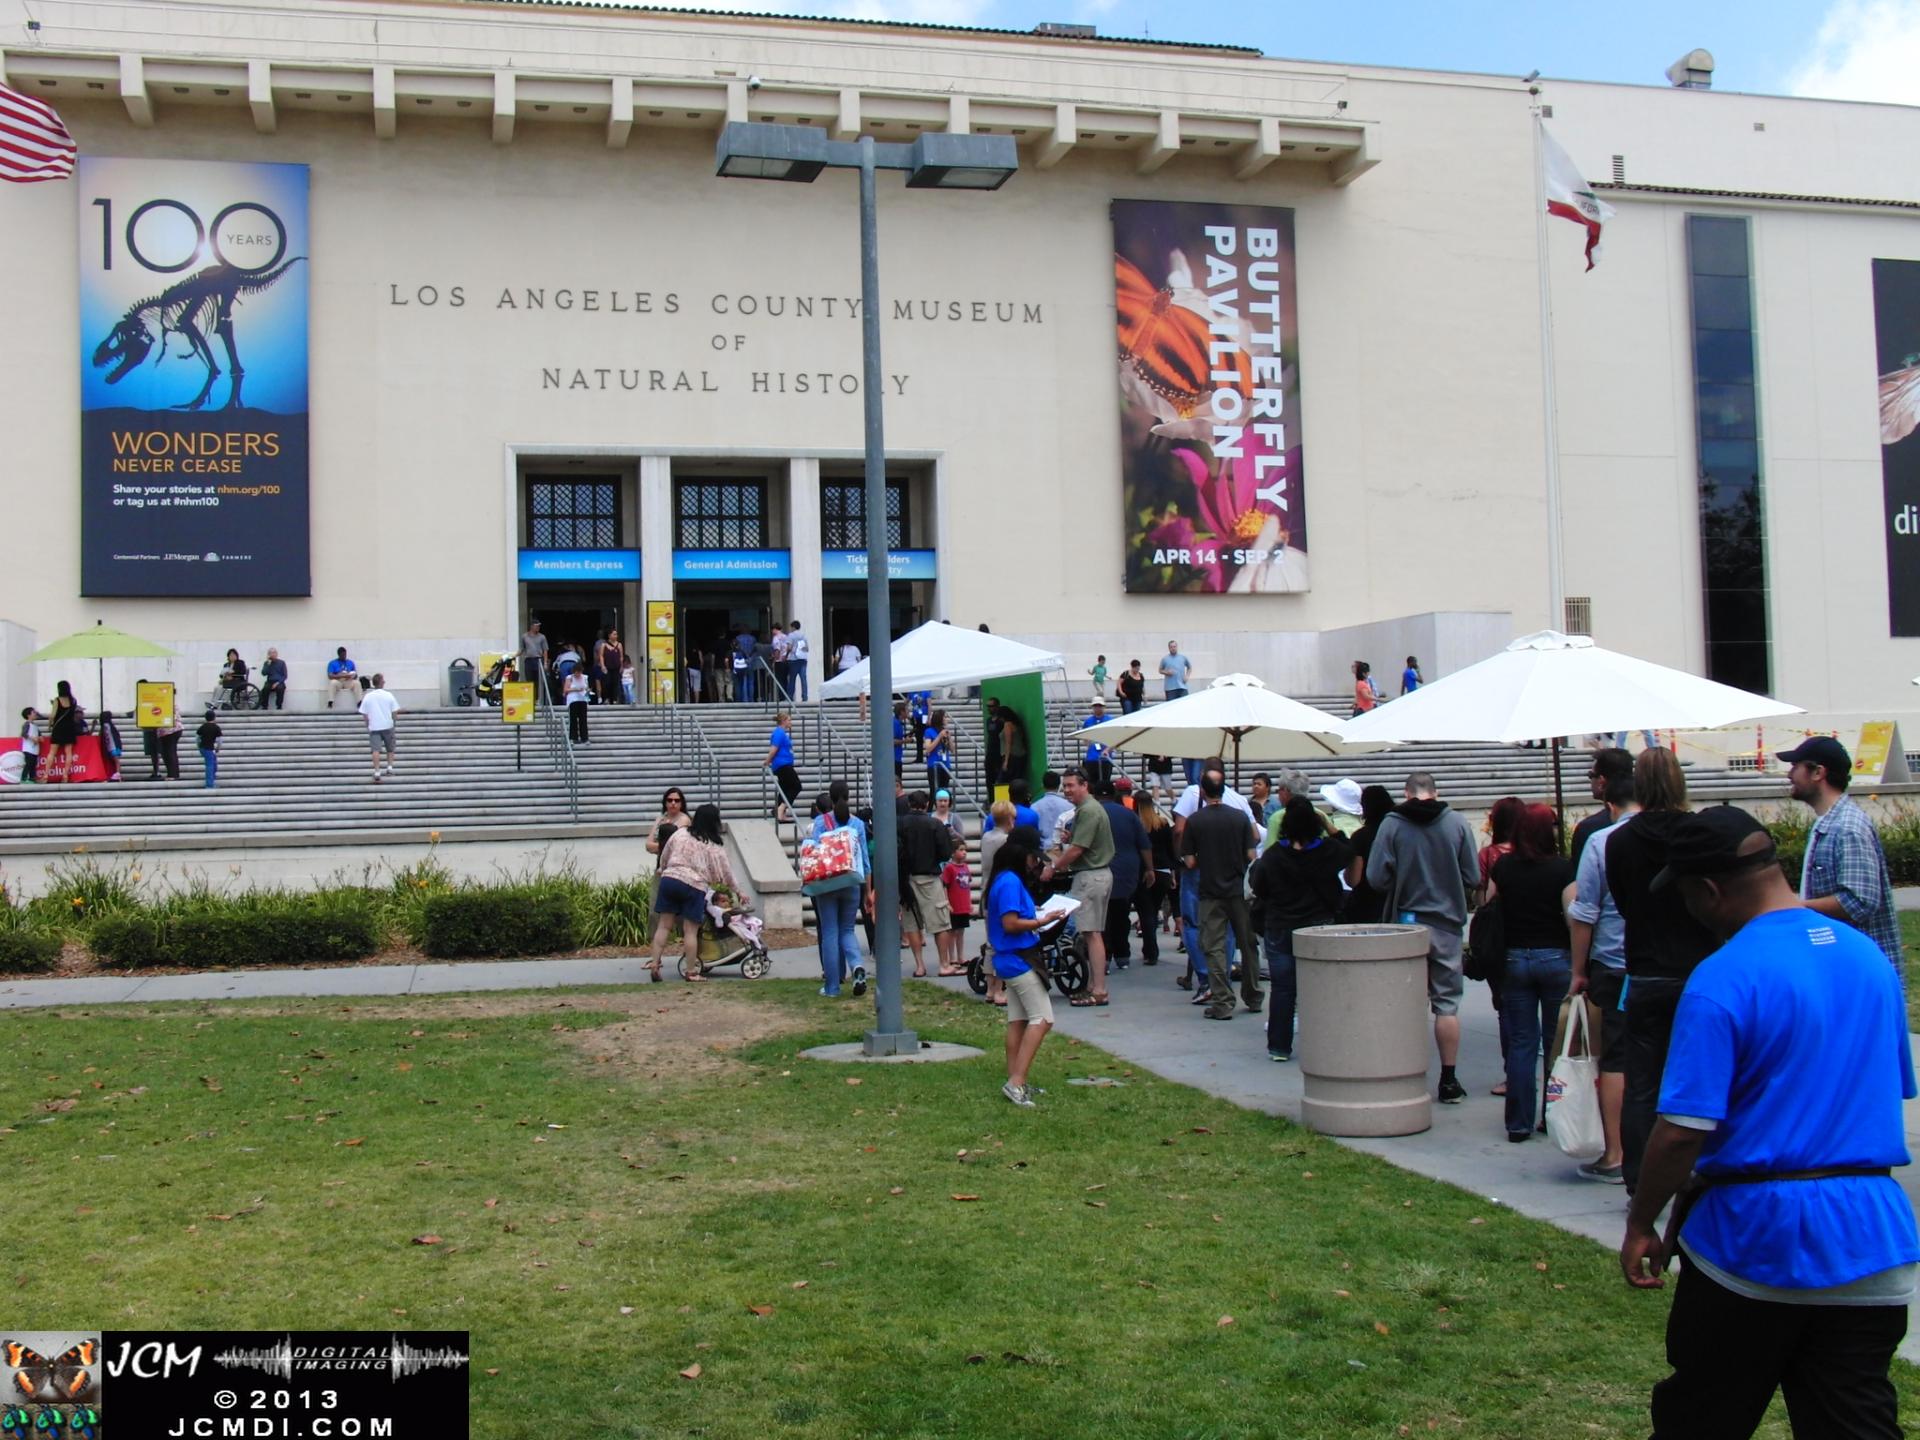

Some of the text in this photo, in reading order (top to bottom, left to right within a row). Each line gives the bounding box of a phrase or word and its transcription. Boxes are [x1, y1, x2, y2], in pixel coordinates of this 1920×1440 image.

[92, 198, 287, 273] 100
[226, 234, 273, 246] YEARS
[390, 284, 1044, 324] LOS ANGELES COUNTY MUSEUM
[711, 334, 746, 351] OF
[1205, 225, 1244, 458] PAVILION
[1246, 227, 1288, 511] BUTTERFLY
[541, 368, 910, 395] NATURAL HISTOY
[111, 431, 280, 456] WONDERS
[113, 459, 242, 473] NEVER CEASE
[113, 484, 280, 496] Share your stories at nhm.org/100
[127, 498, 145, 508] tag
[161, 498, 171, 506] at
[173, 497, 220, 506] #nhm100
[1152, 549, 1190, 564] APR
[1196, 549, 1216, 564] 14
[1233, 549, 1268, 564] SEP
[1272, 549, 1284, 564] 2
[534, 560, 623, 572] Members Express
[684, 560, 778, 570] General Admission
[37, 764, 86, 777] evoluion
